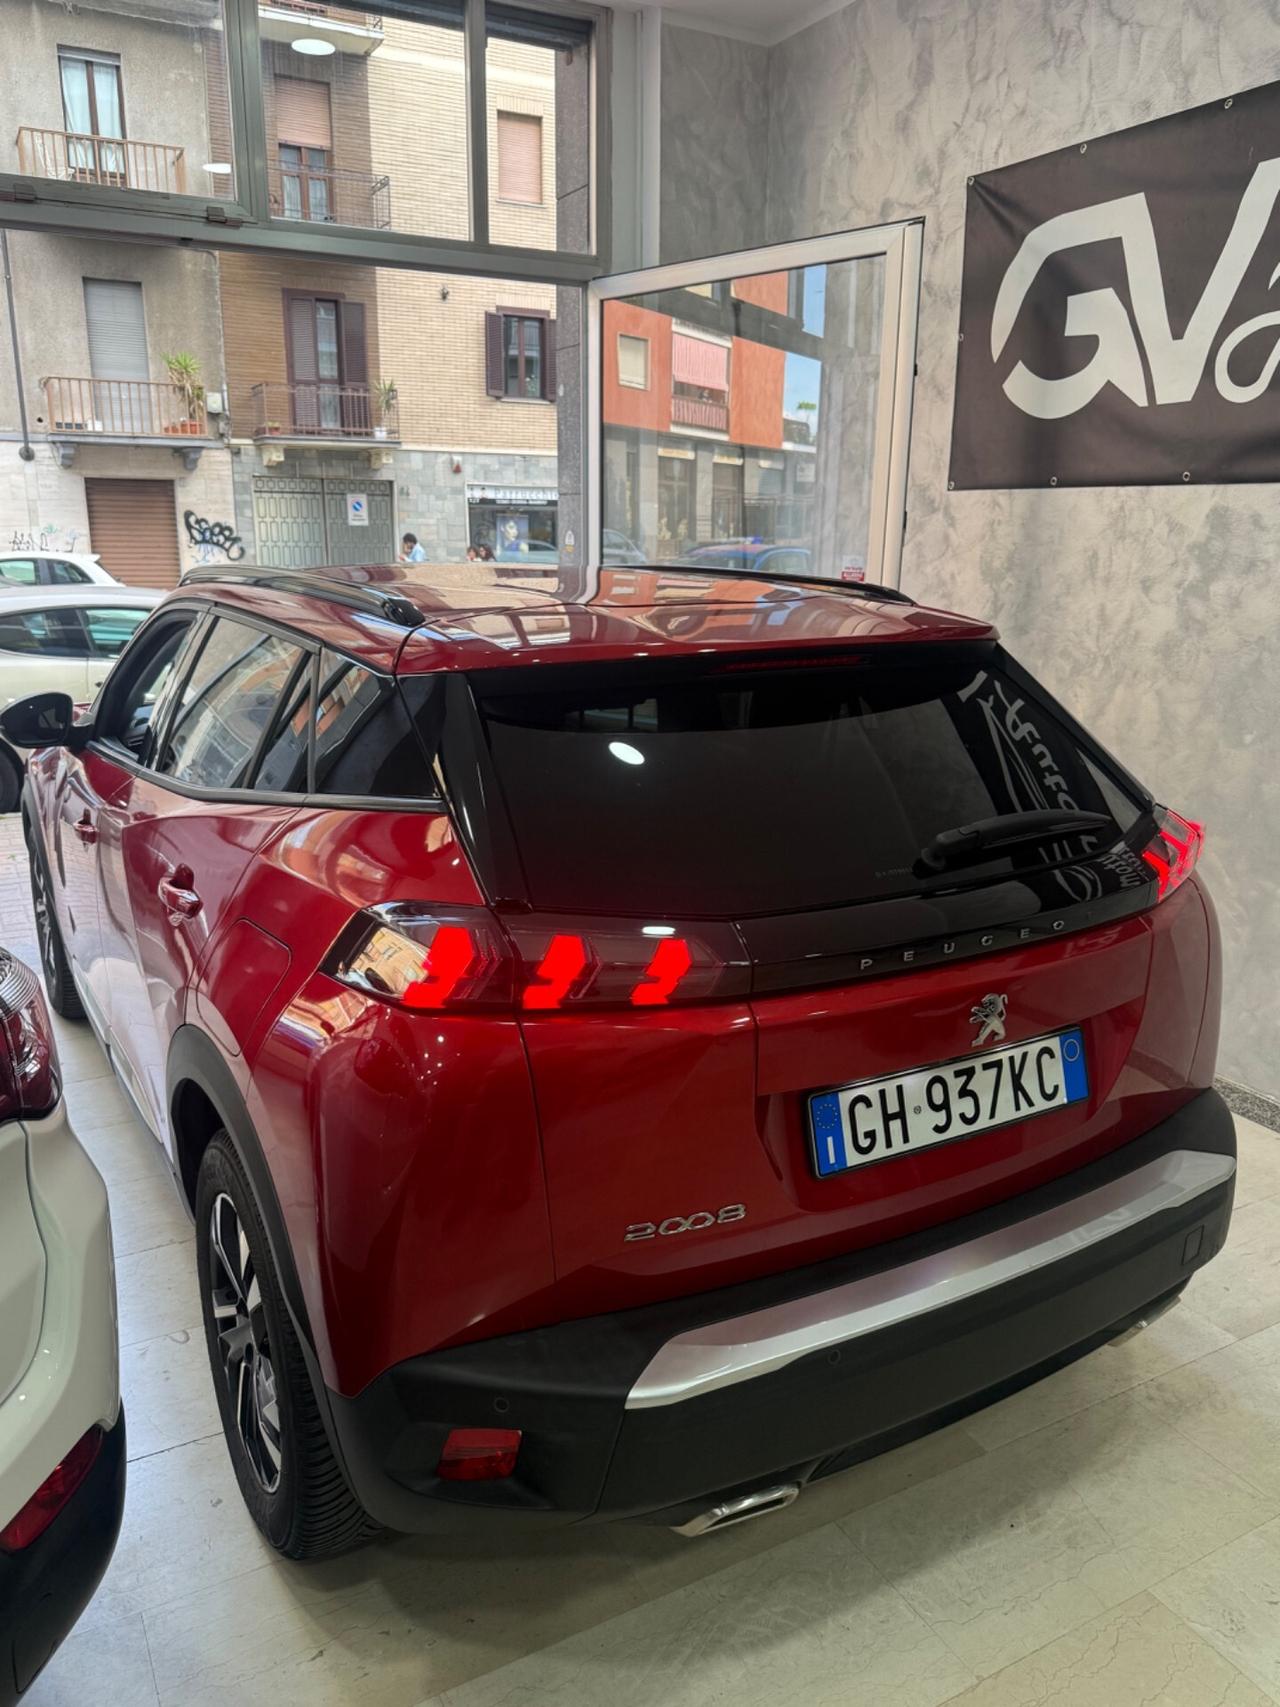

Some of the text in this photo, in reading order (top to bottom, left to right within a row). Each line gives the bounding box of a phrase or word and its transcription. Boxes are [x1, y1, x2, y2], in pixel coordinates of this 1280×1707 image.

[860, 913, 1088, 971] PEUGEO
[848, 1085, 910, 1155] GH
[925, 1046, 1060, 1134] 937KC
[624, 1203, 746, 1242] 2008
